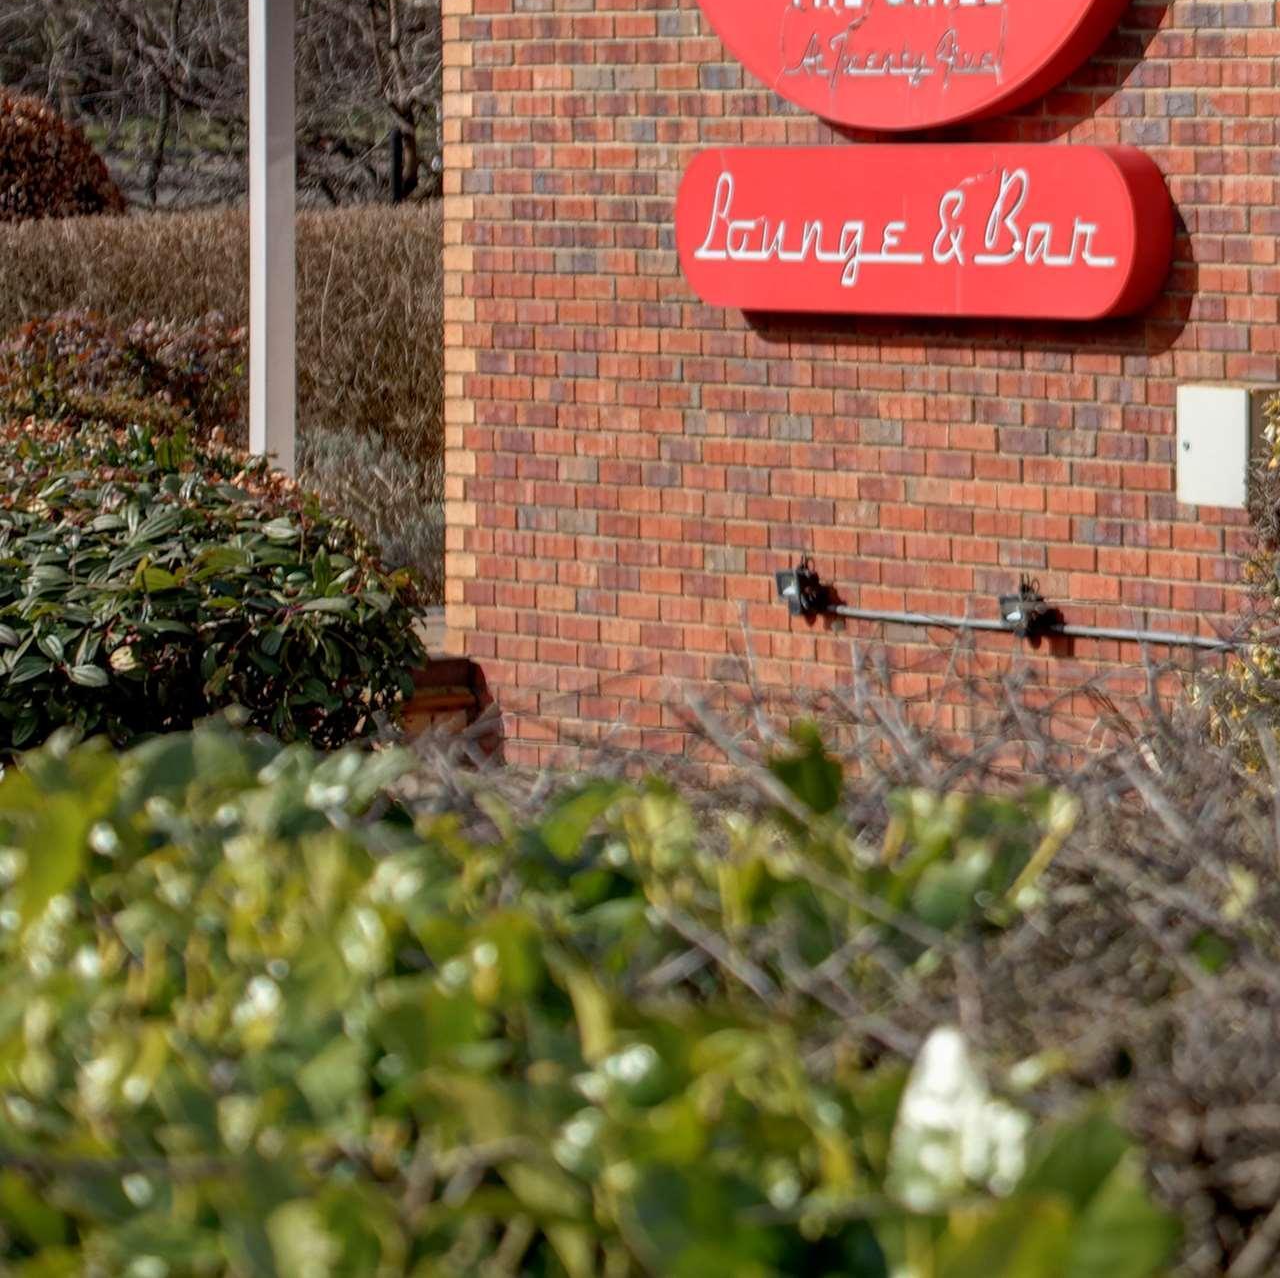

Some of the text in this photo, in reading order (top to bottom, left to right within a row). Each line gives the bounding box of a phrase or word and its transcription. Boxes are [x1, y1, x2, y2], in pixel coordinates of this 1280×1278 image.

[694, 168, 1118, 287] Lounge & Bar
